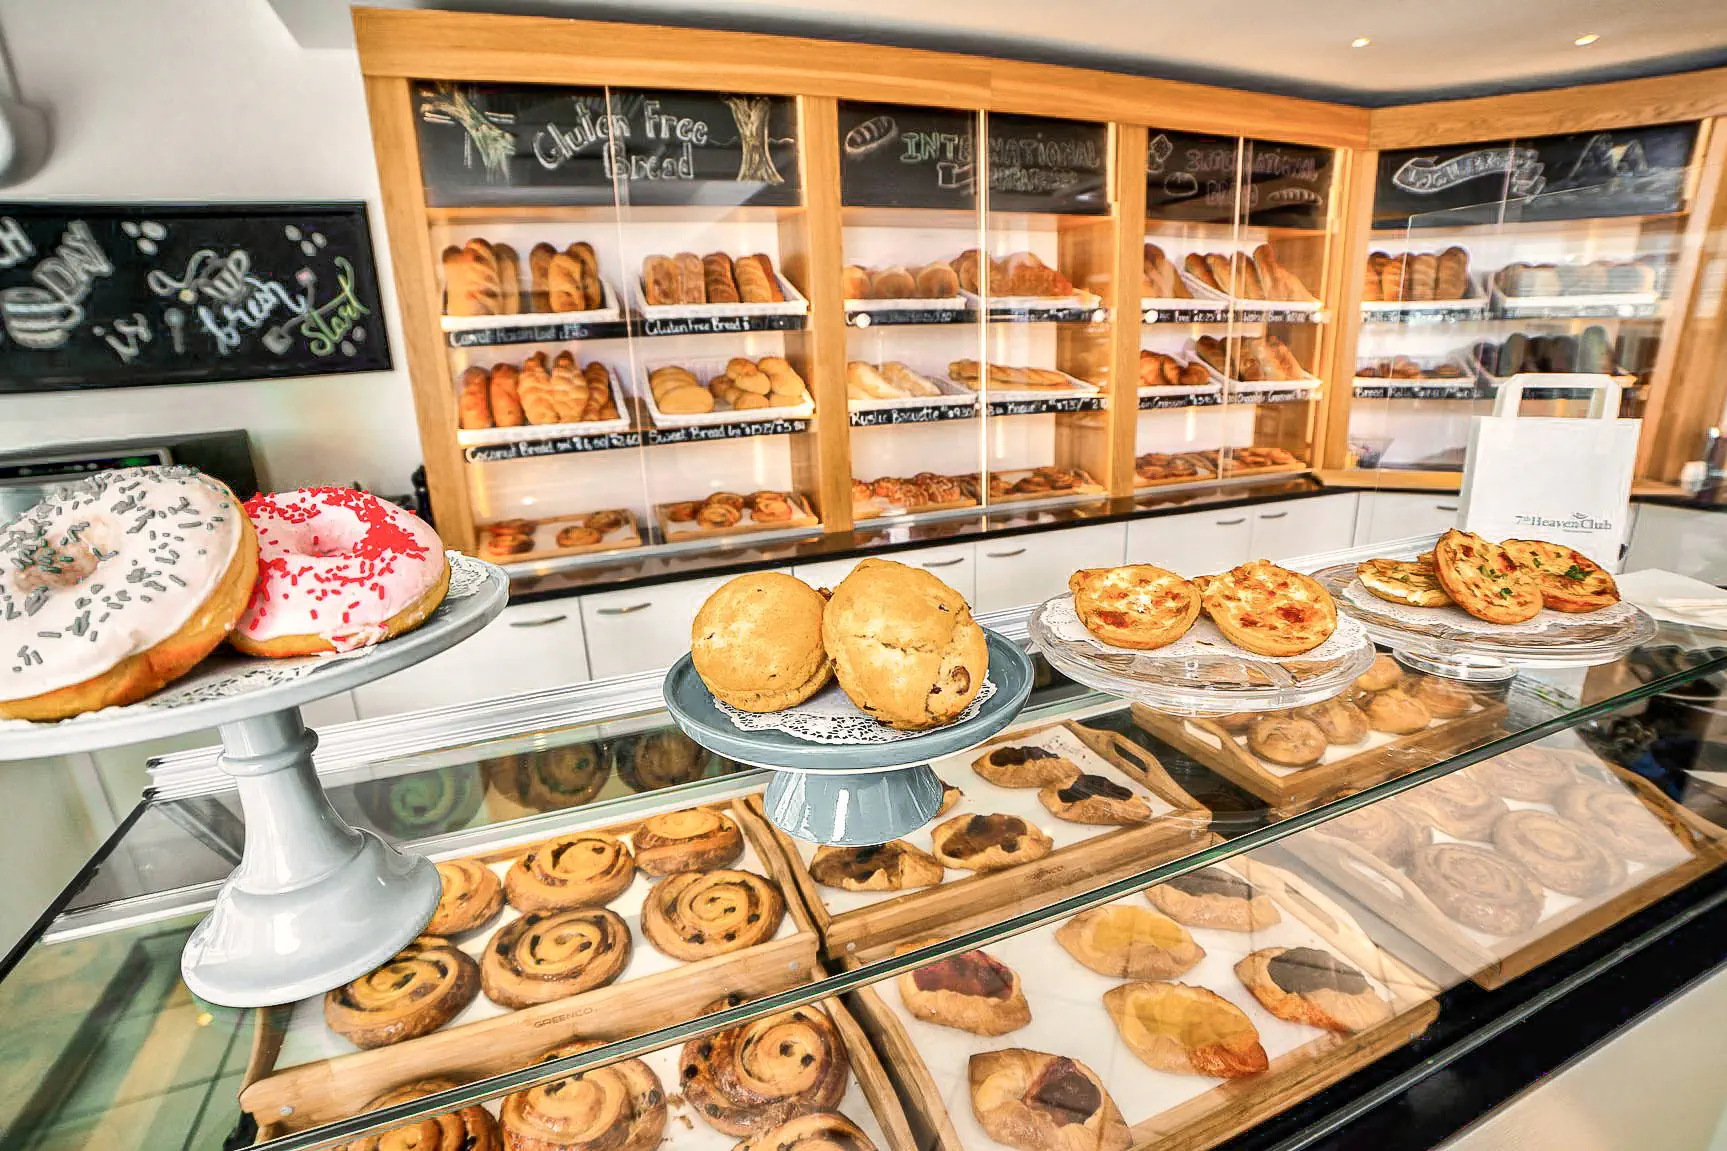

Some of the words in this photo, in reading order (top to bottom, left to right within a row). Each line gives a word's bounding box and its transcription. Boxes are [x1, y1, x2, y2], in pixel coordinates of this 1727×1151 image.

[644, 100, 708, 145] Free
[1531, 516, 1580, 529] Heaven
[1581, 519, 1612, 530] Club
[534, 1007, 593, 1028] GREENCO
